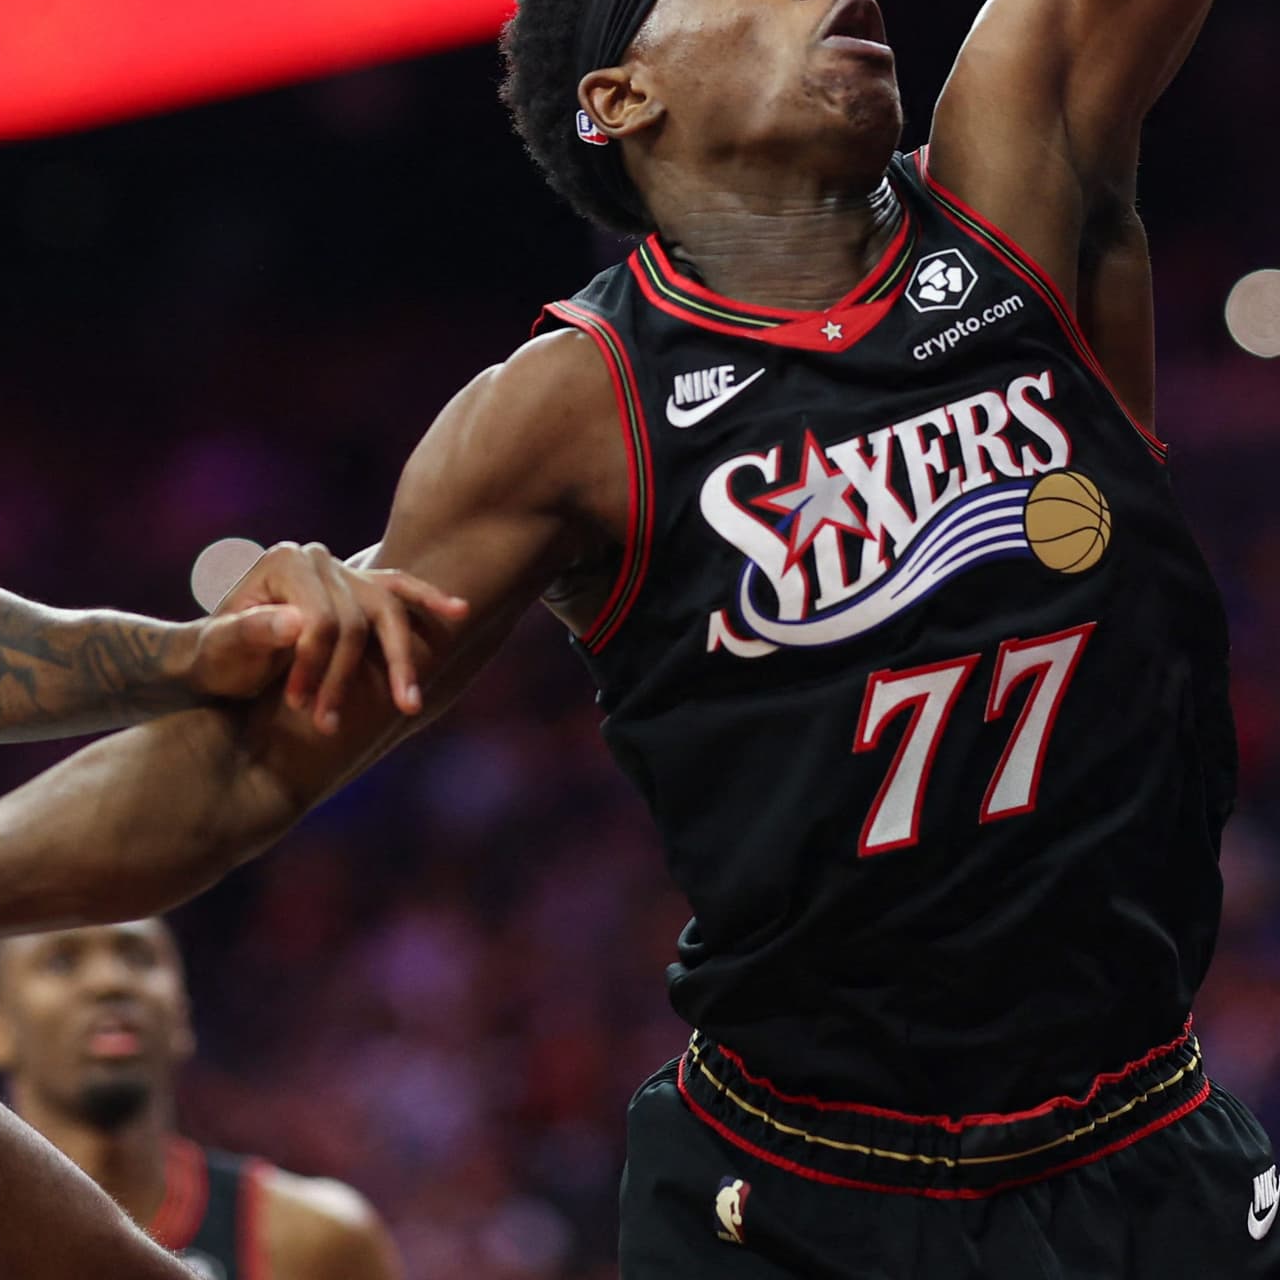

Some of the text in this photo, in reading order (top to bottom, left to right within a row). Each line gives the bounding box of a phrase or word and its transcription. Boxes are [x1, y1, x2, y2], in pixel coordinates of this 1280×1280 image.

[912, 294, 1025, 361] crypto.com
[673, 364, 736, 406] NIKE
[851, 621, 1097, 858] 77
[1252, 1164, 1278, 1214] NIKE
